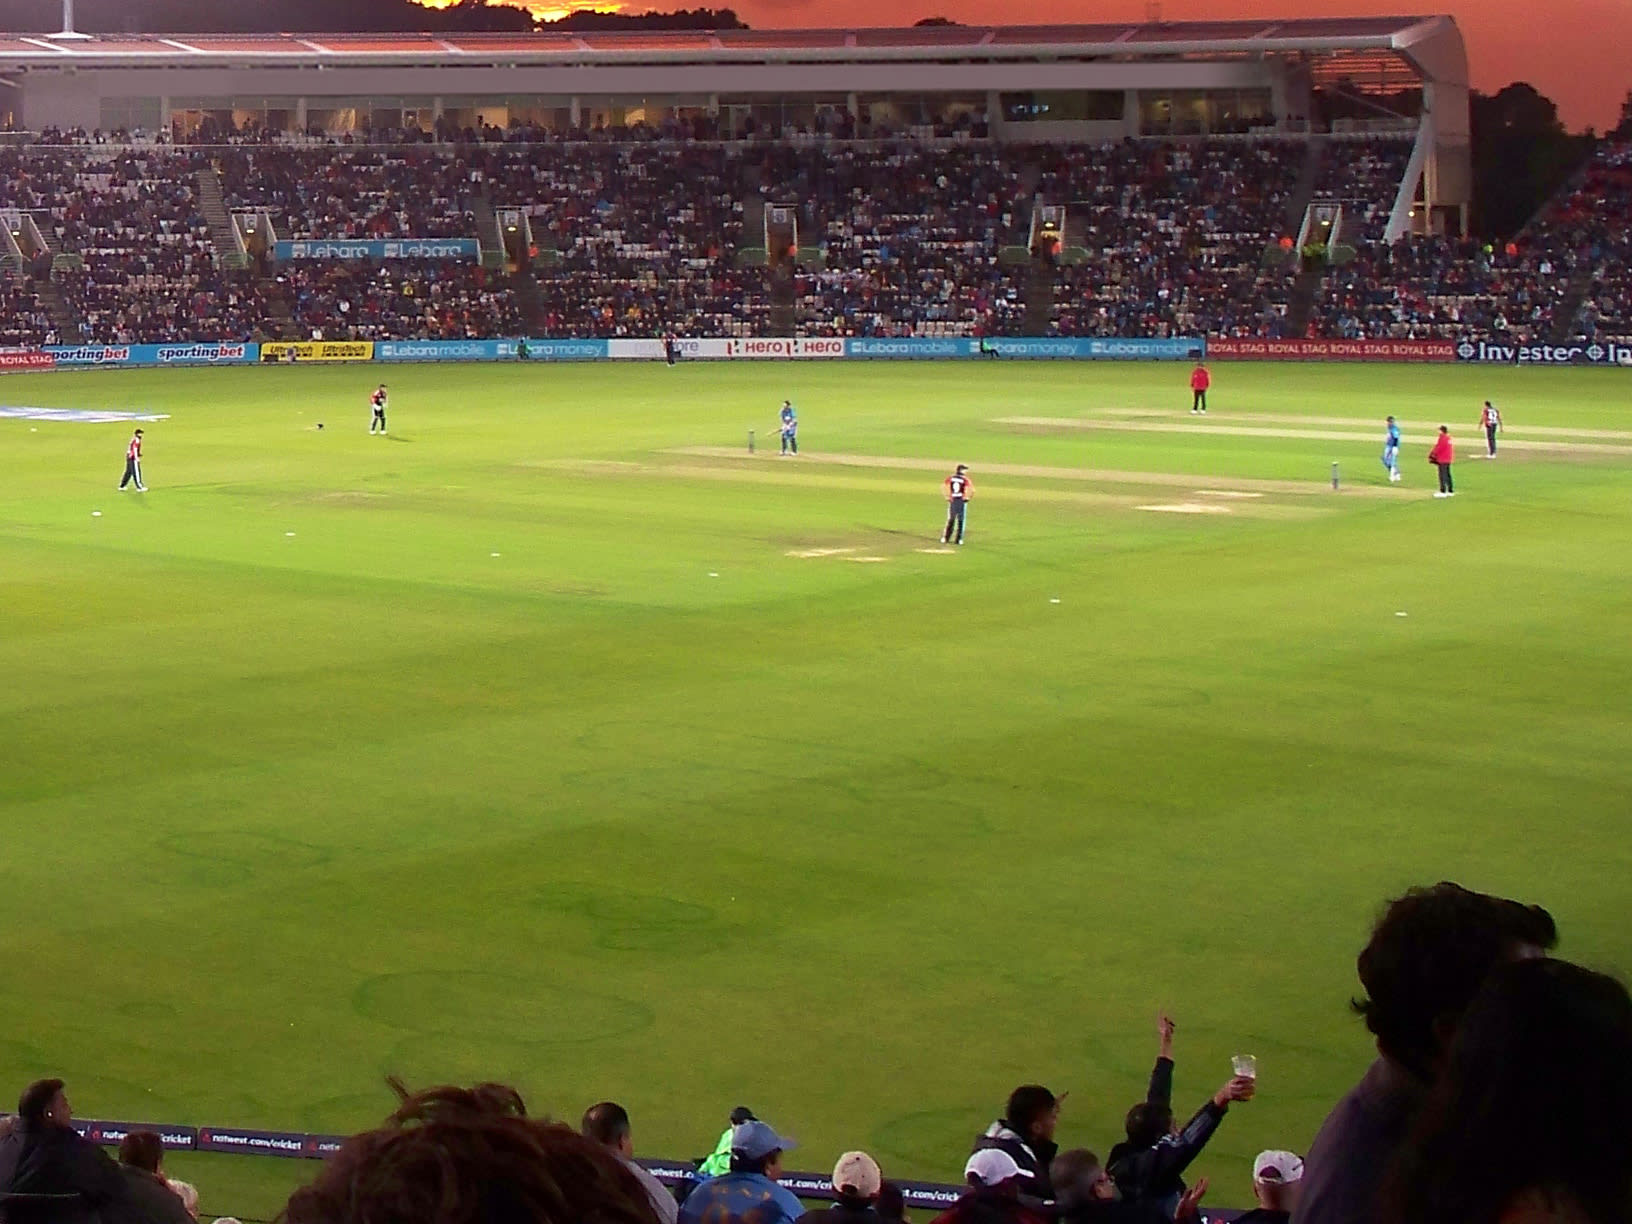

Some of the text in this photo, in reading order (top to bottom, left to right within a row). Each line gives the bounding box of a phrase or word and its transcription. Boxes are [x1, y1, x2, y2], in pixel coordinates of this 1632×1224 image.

[54, 346, 129, 363] portingbet
[159, 345, 245, 361] sportingbet
[393, 344, 485, 356] Lebara mobile
[555, 344, 602, 358] money
[1208, 343, 1453, 356] ROYAL STAG ROYAL STAG ROYAL STAG ROYAL STAG
[0, 355, 29, 366] ROYAL
[31, 354, 53, 364] STAG
[212, 1134, 302, 1151] natwest.com/cricket
